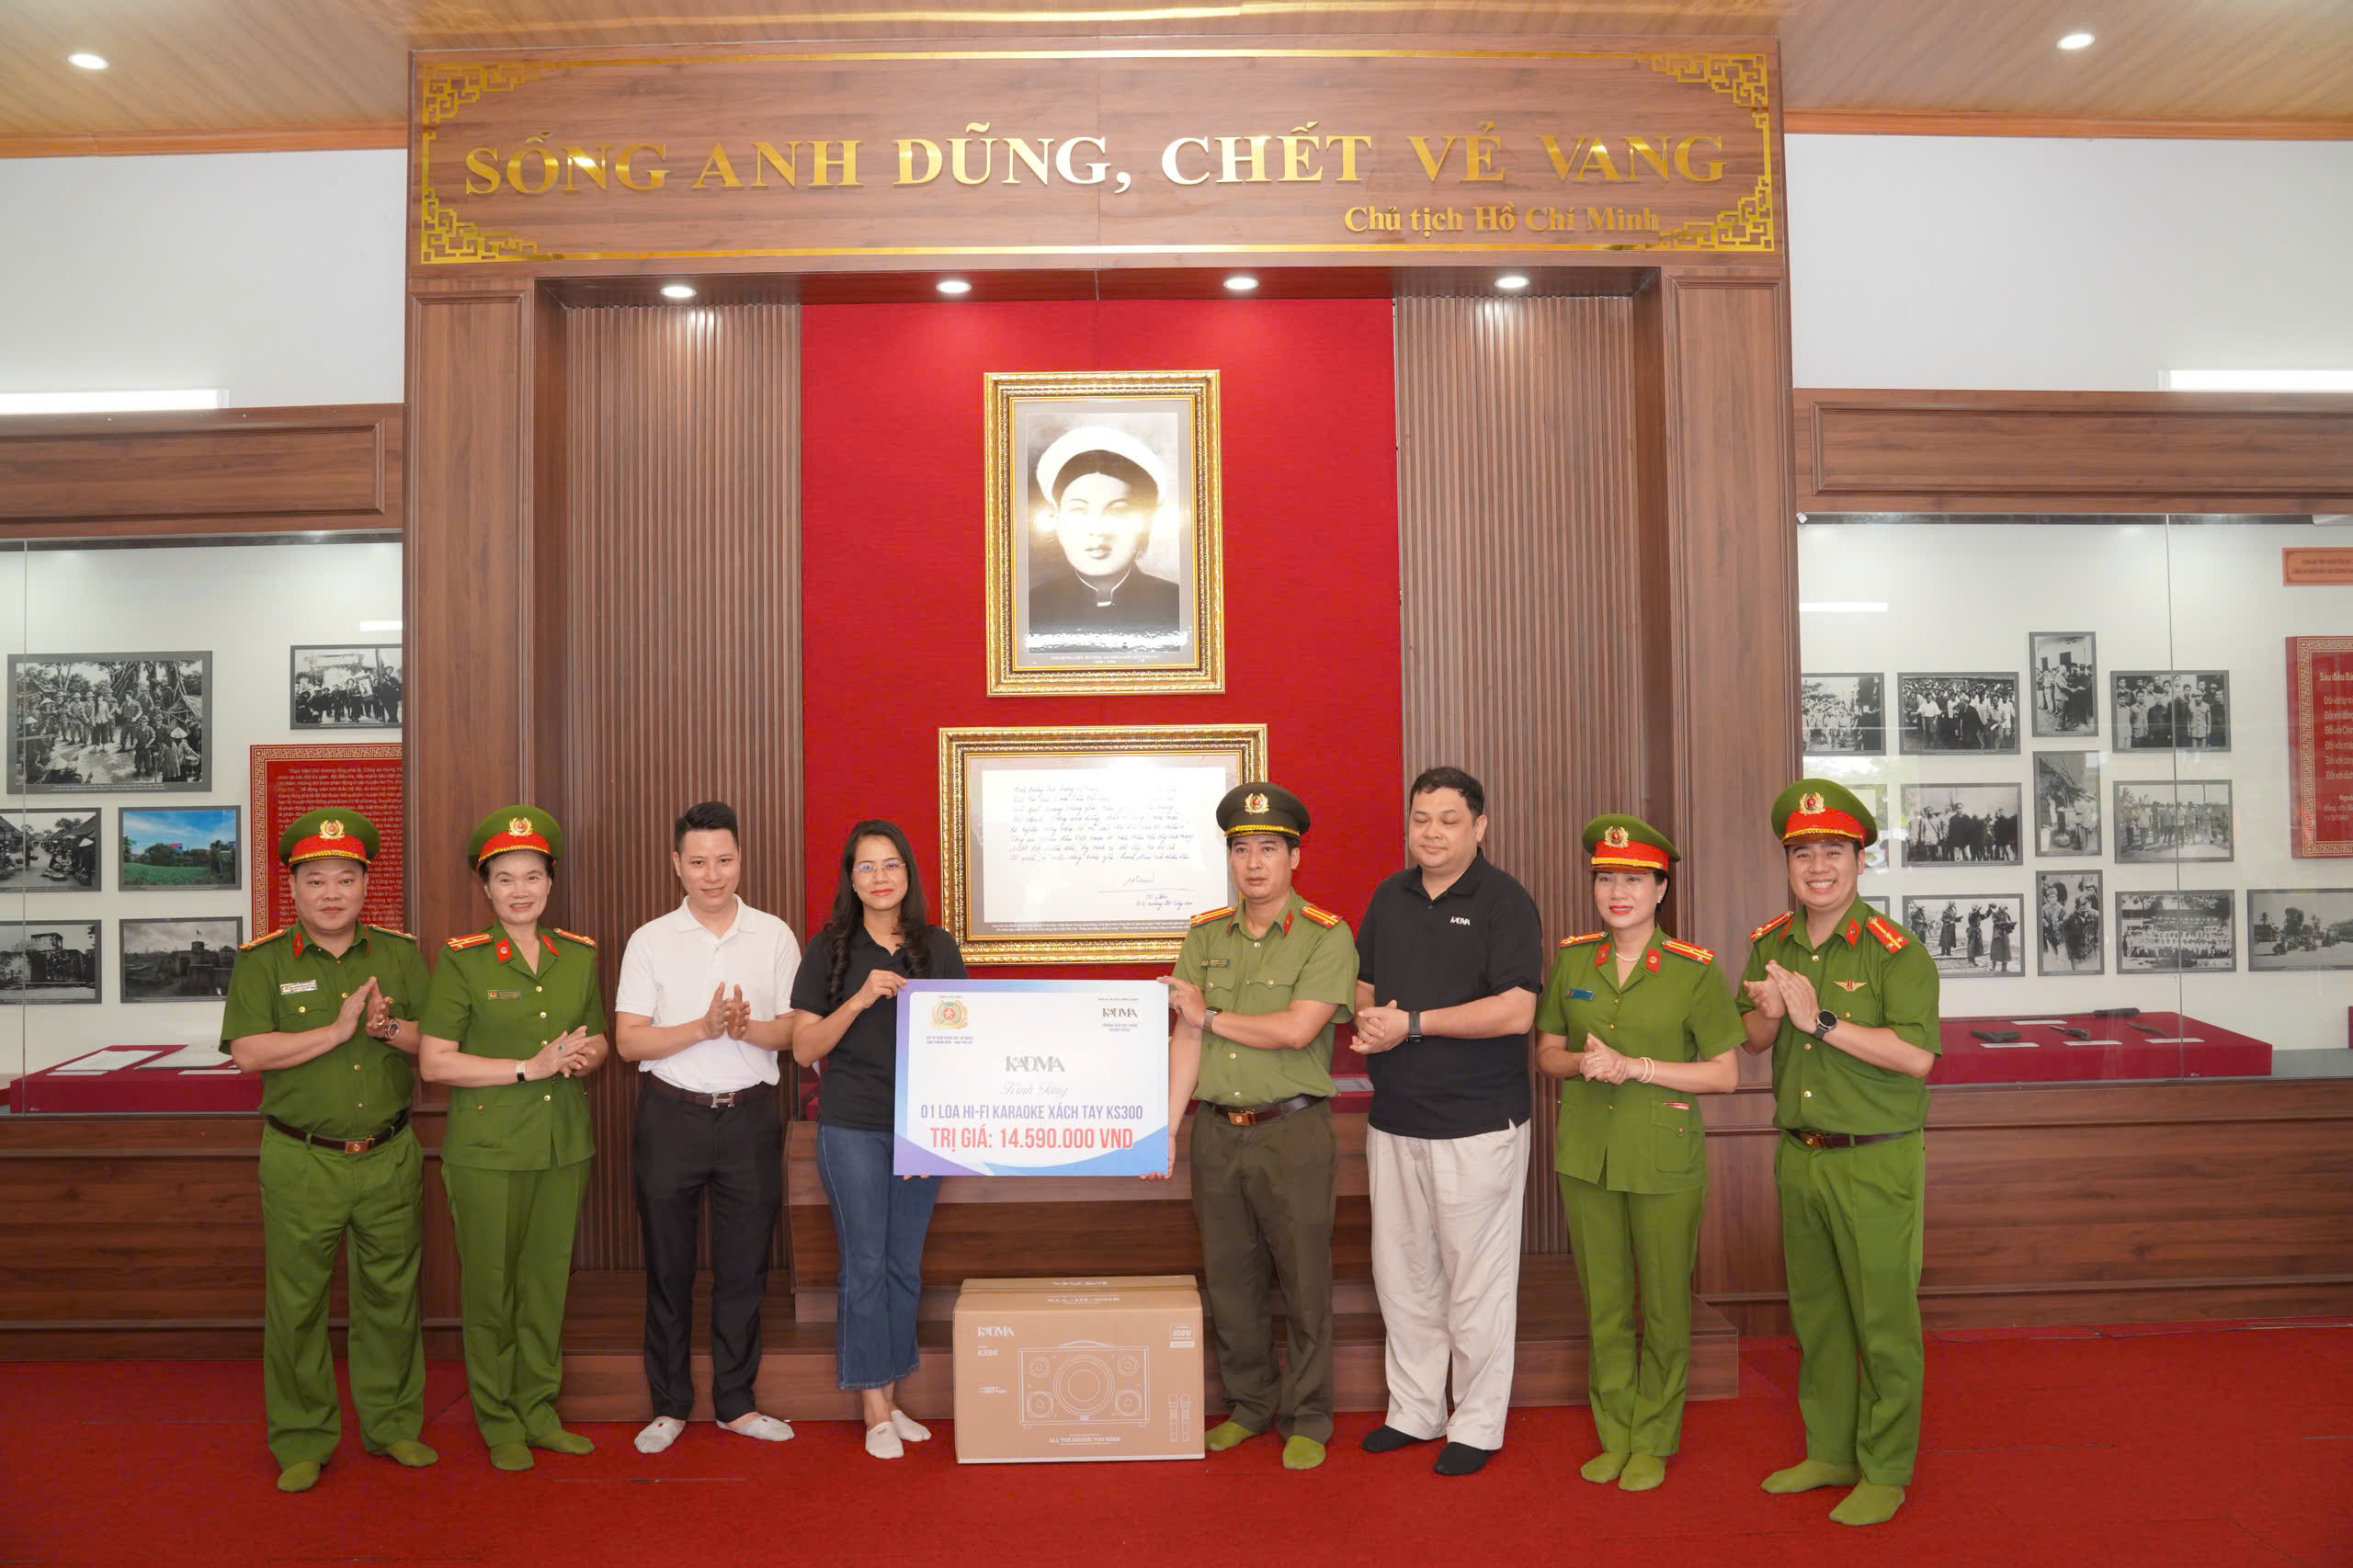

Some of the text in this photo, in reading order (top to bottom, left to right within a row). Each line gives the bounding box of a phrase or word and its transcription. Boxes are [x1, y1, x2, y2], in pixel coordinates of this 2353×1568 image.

[464, 120, 1727, 196] SỐNG ANH DŨNG, CHẾT VẺ VANG
[1344, 199, 1659, 238] Chủ tịch Hồ Chí Minh
[921, 1102, 1143, 1119] 01 LOA HI-FI KARAOKE XÁCH TAY KS300
[930, 1123, 1133, 1153] TRỊ GIÁ: 14.590.000 VND
